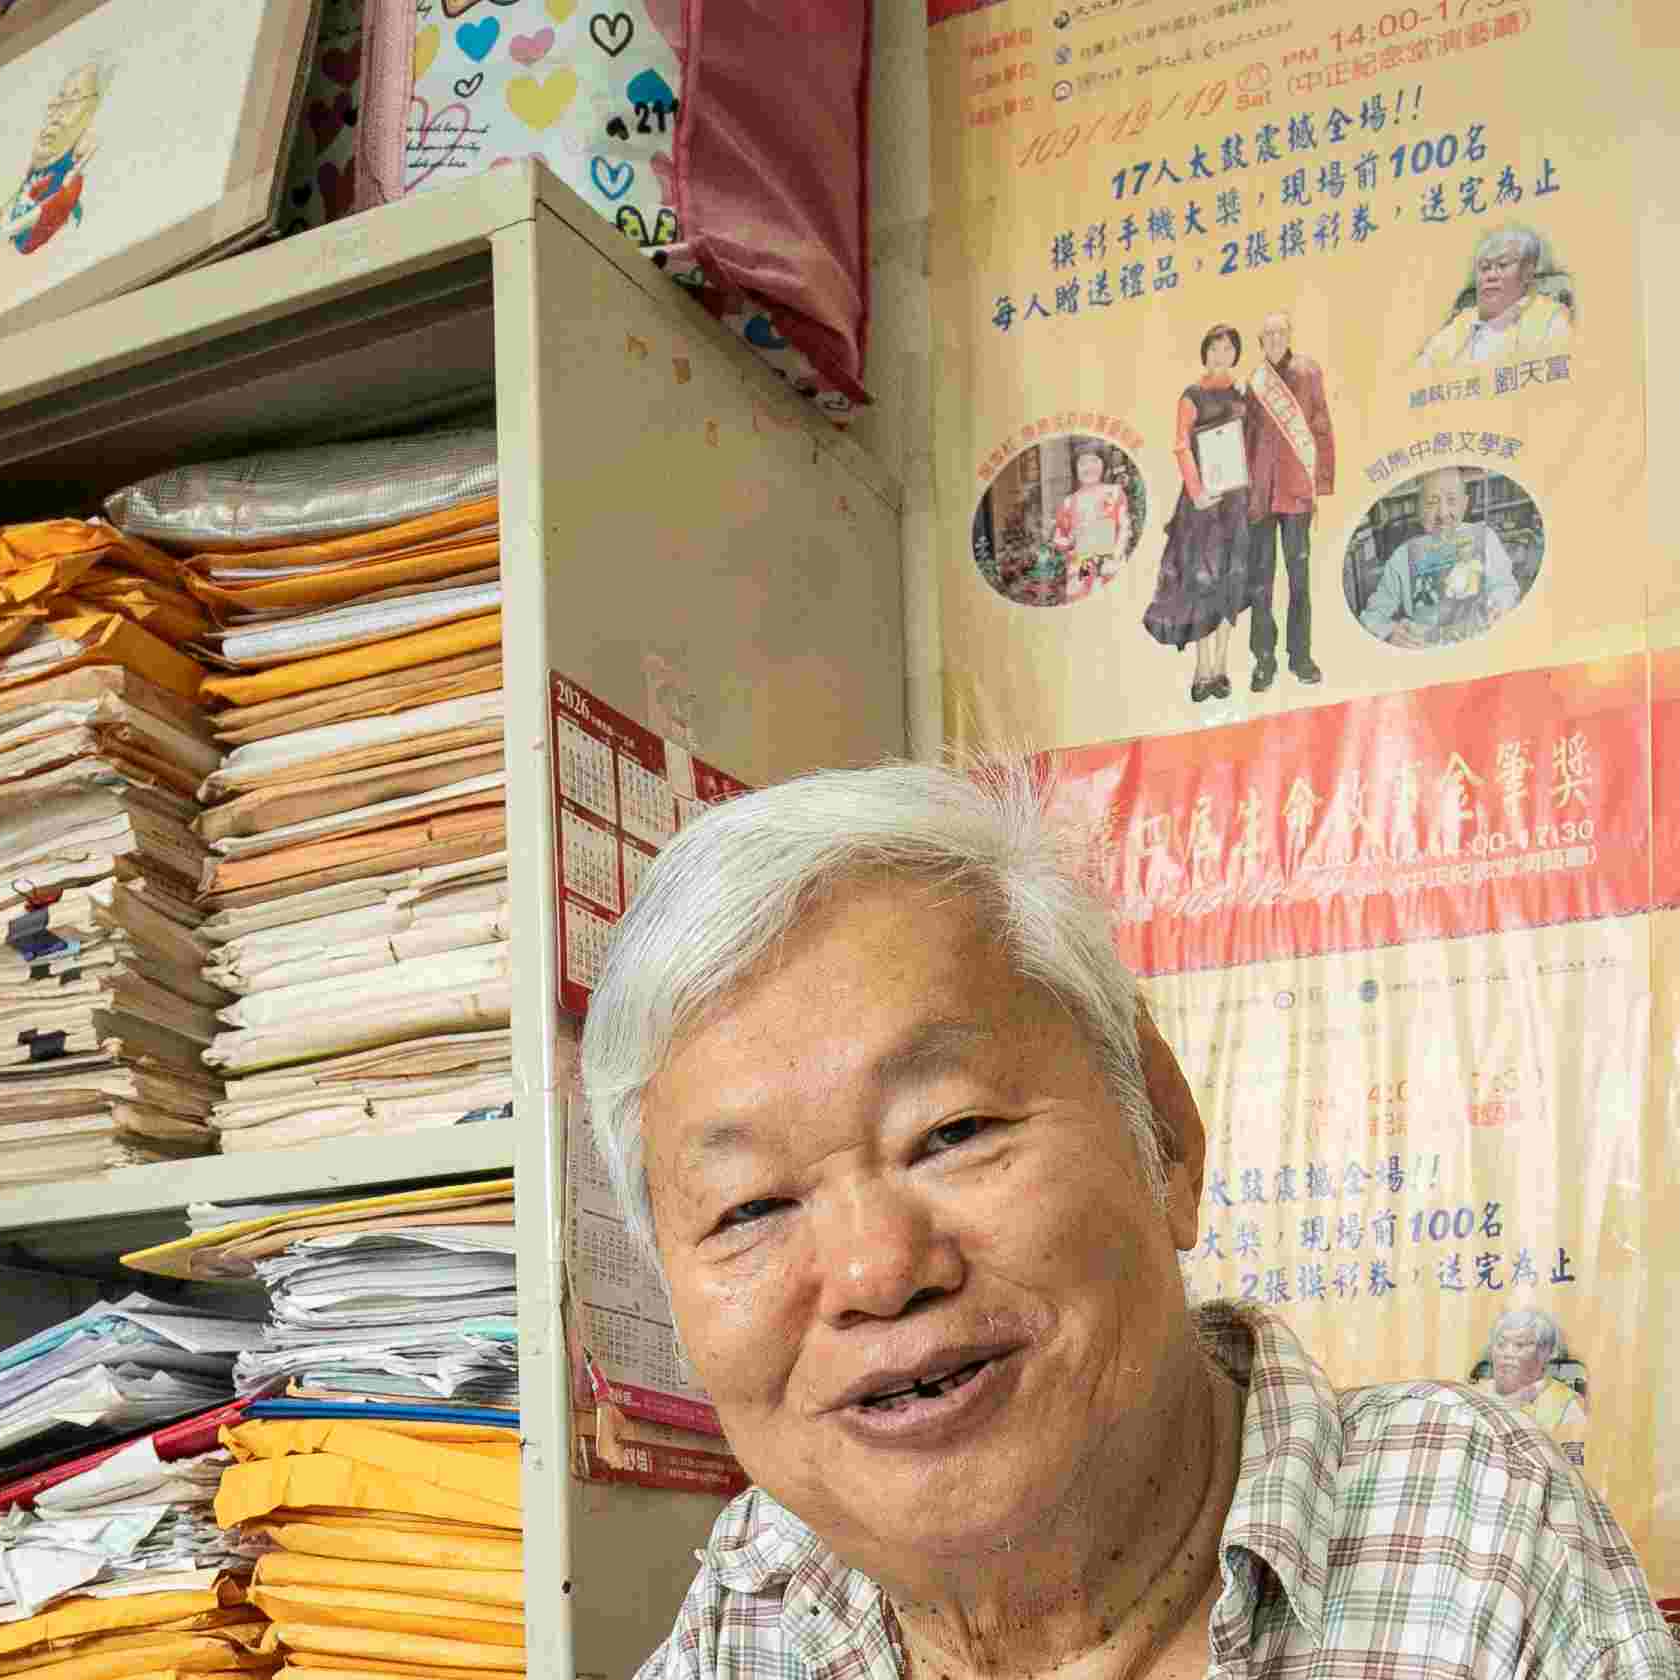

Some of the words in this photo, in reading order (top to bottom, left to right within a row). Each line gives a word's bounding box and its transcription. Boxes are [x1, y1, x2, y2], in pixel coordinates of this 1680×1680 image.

[1493, 354, 1571, 395] 劉天富
[1363, 430, 1523, 485] 司馬中原文學家
[1178, 1200, 1505, 1263] 大獎，現場前100名
[1184, 1247, 1576, 1306] ，2張摸彩券，送完為止
